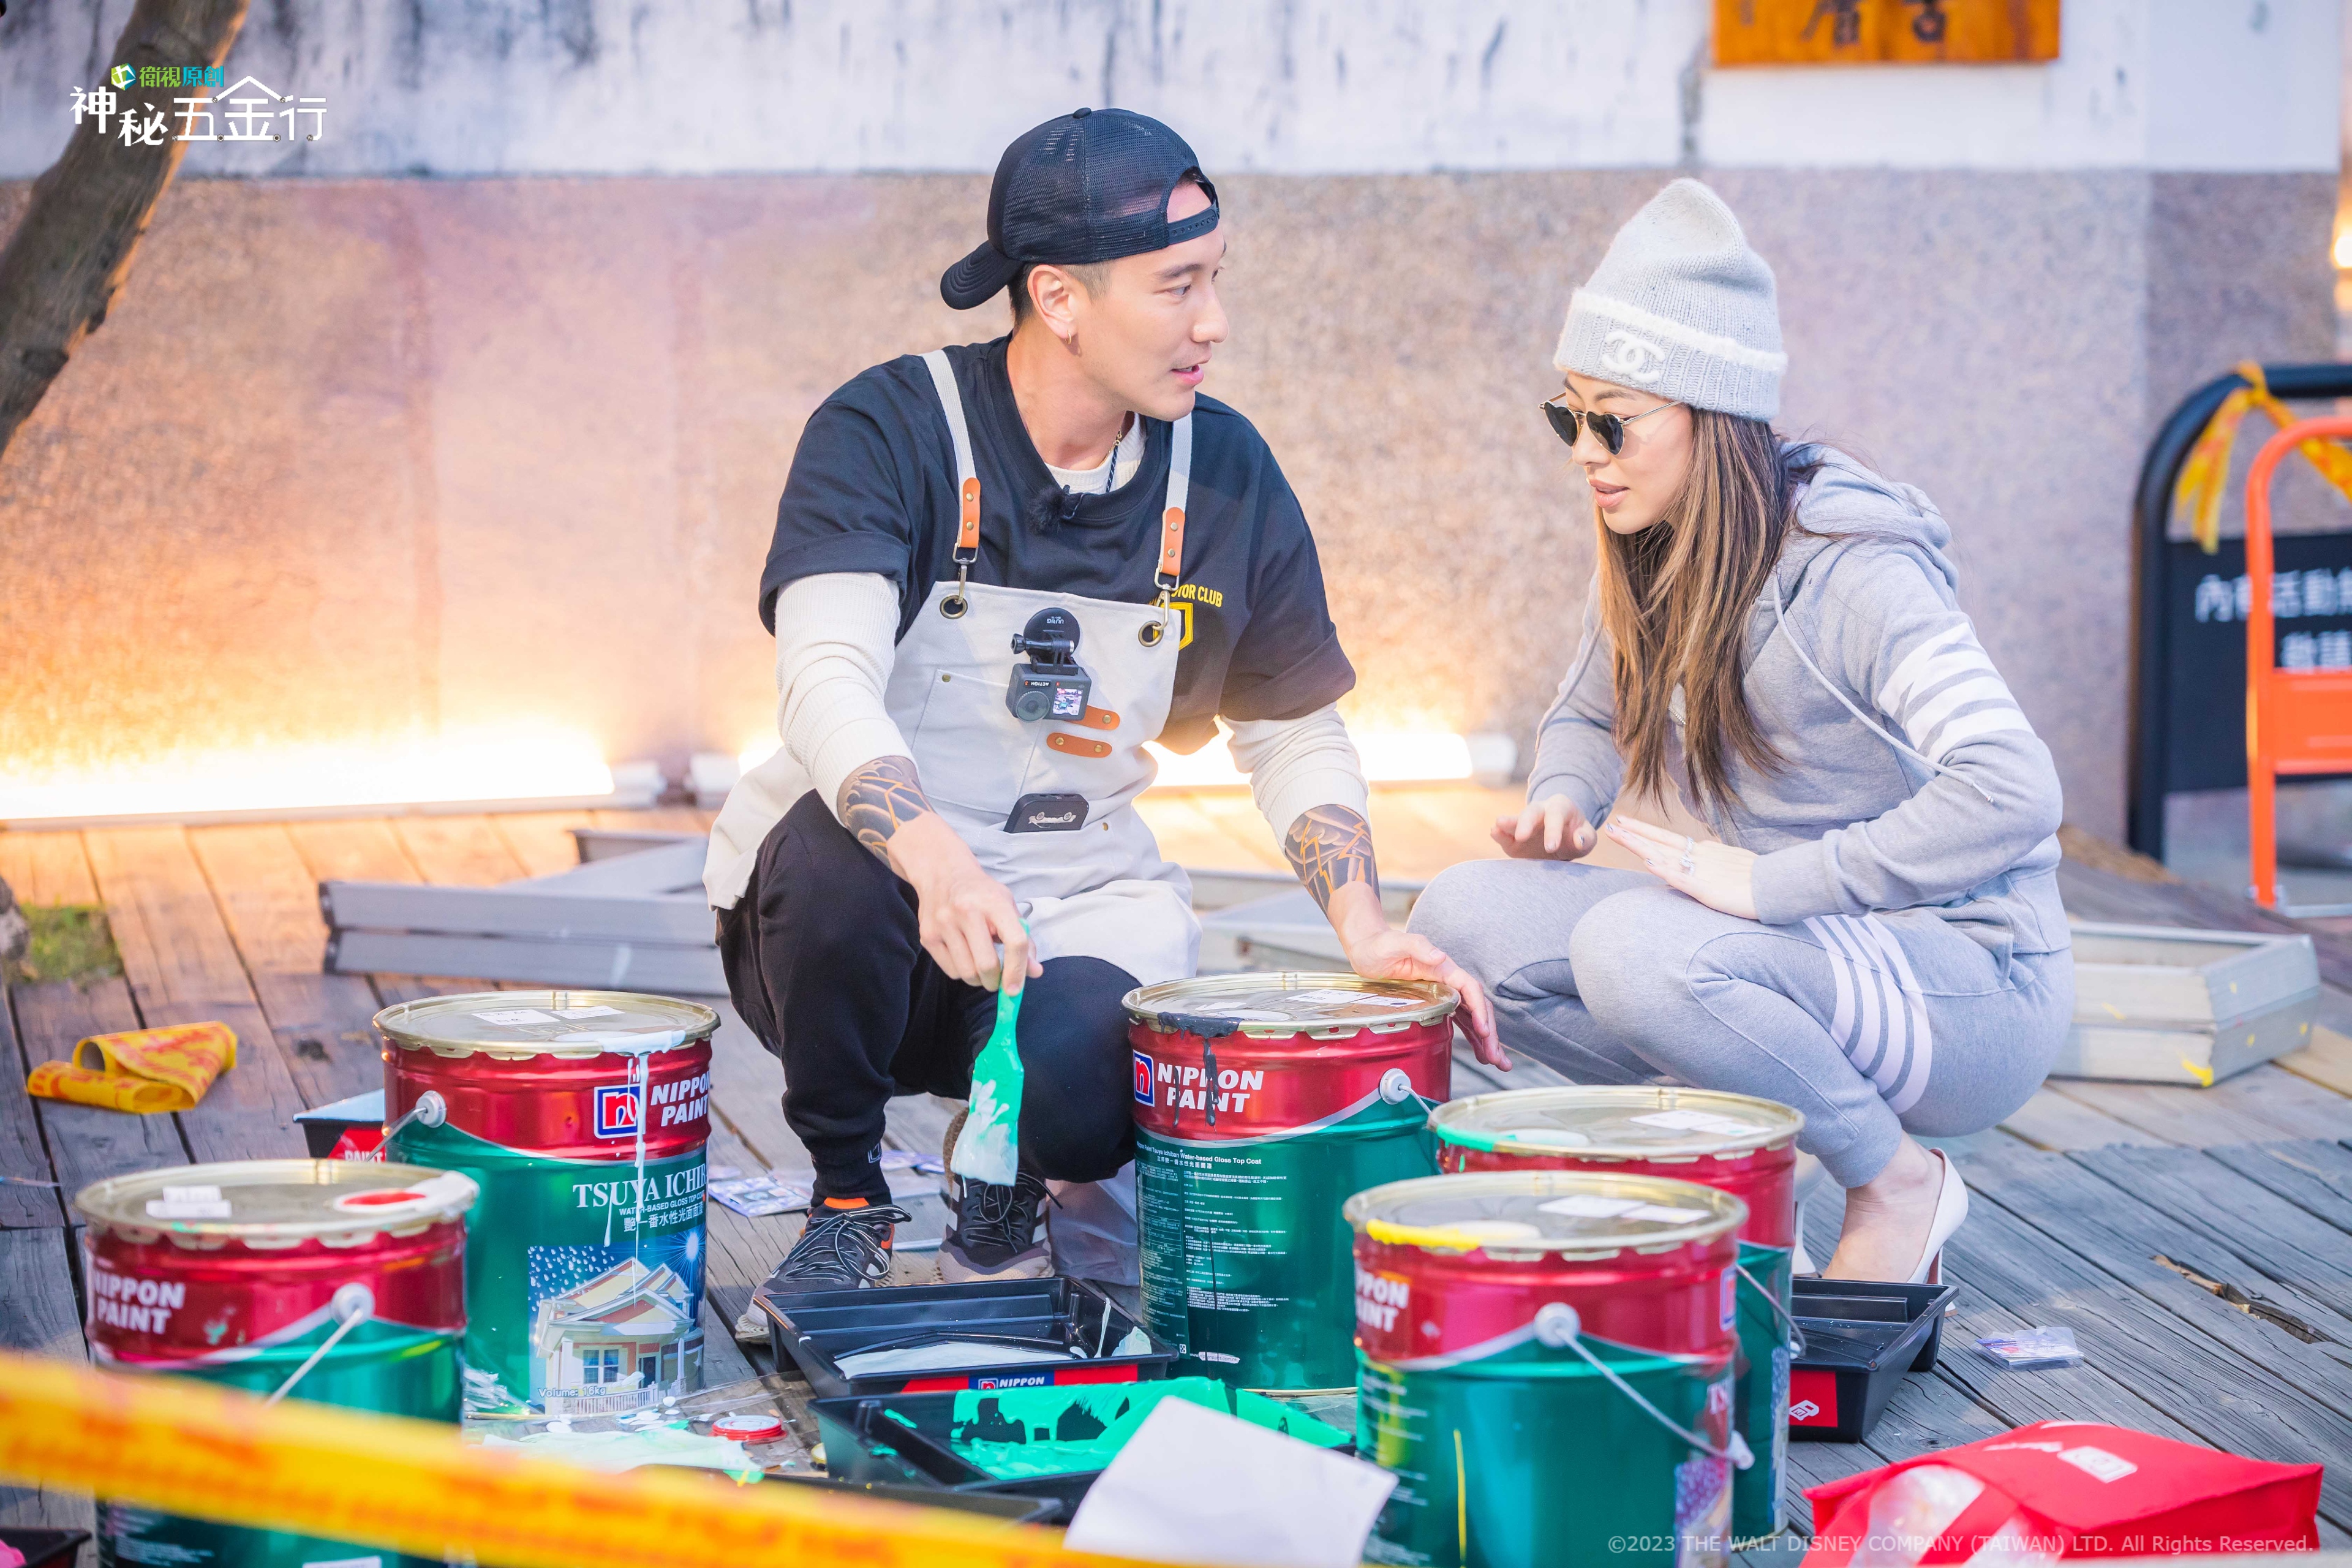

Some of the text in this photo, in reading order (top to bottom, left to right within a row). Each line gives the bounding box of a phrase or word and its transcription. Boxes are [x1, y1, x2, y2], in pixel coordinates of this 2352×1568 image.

[1197, 586, 1223, 608] CLUB
[661, 1094, 708, 1127] PAINT
[1152, 1147, 1163, 1156] Tsuya
[1163, 1150, 1180, 1158] Ichiban
[1180, 1152, 1213, 1162] Water-based
[1232, 1157, 1245, 1166] Top
[572, 1163, 707, 1208] TSUYA ICHIB
[669, 1197, 688, 1208] GLOSS
[97, 1295, 173, 1335] PAINT
[538, 1385, 606, 1397] Volume: 16kg
[999, 1376, 1045, 1388] NIPPON
